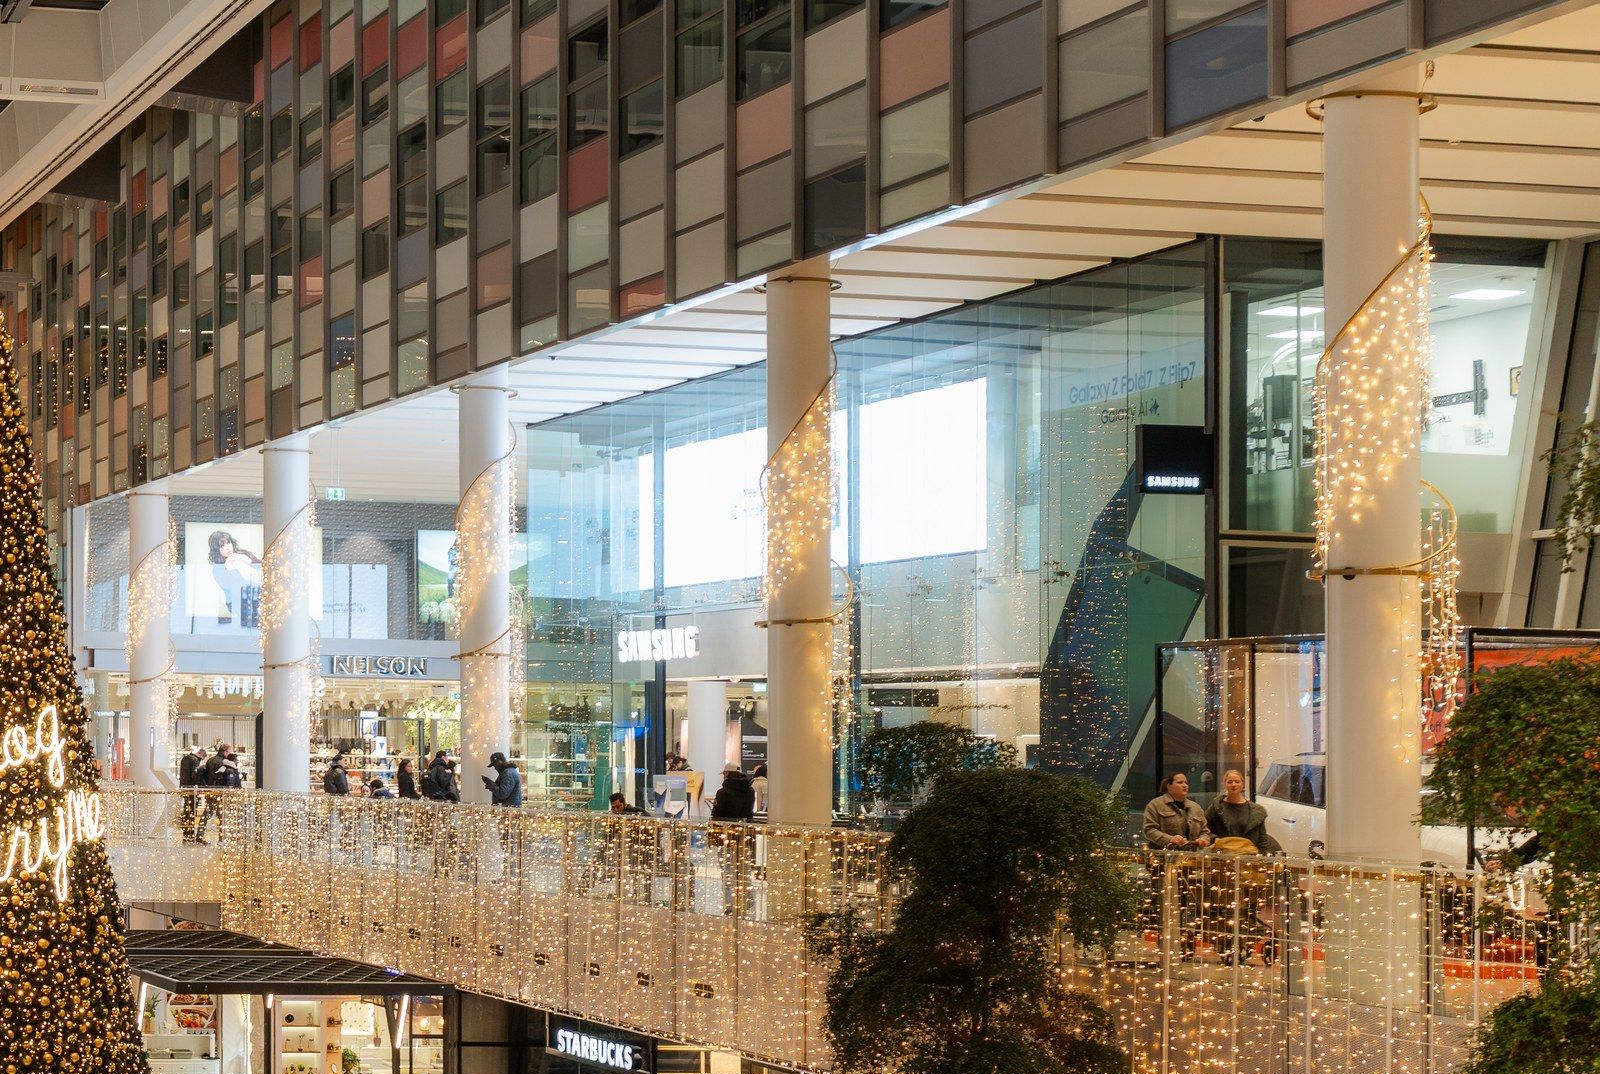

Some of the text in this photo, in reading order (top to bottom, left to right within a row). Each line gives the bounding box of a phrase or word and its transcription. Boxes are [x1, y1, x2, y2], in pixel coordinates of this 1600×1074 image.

[1069, 382, 1110, 404] Galaxy
[1111, 376, 1119, 396] Z
[1120, 369, 1153, 394] Fold7
[1168, 361, 1196, 389] Flip7
[1101, 406, 1136, 425] Galaxy
[1147, 475, 1200, 488] SAMSUNG
[618, 625, 699, 663] SAMSUNG
[331, 655, 427, 677] NELSON
[556, 1028, 634, 1071] STARBUCKS
